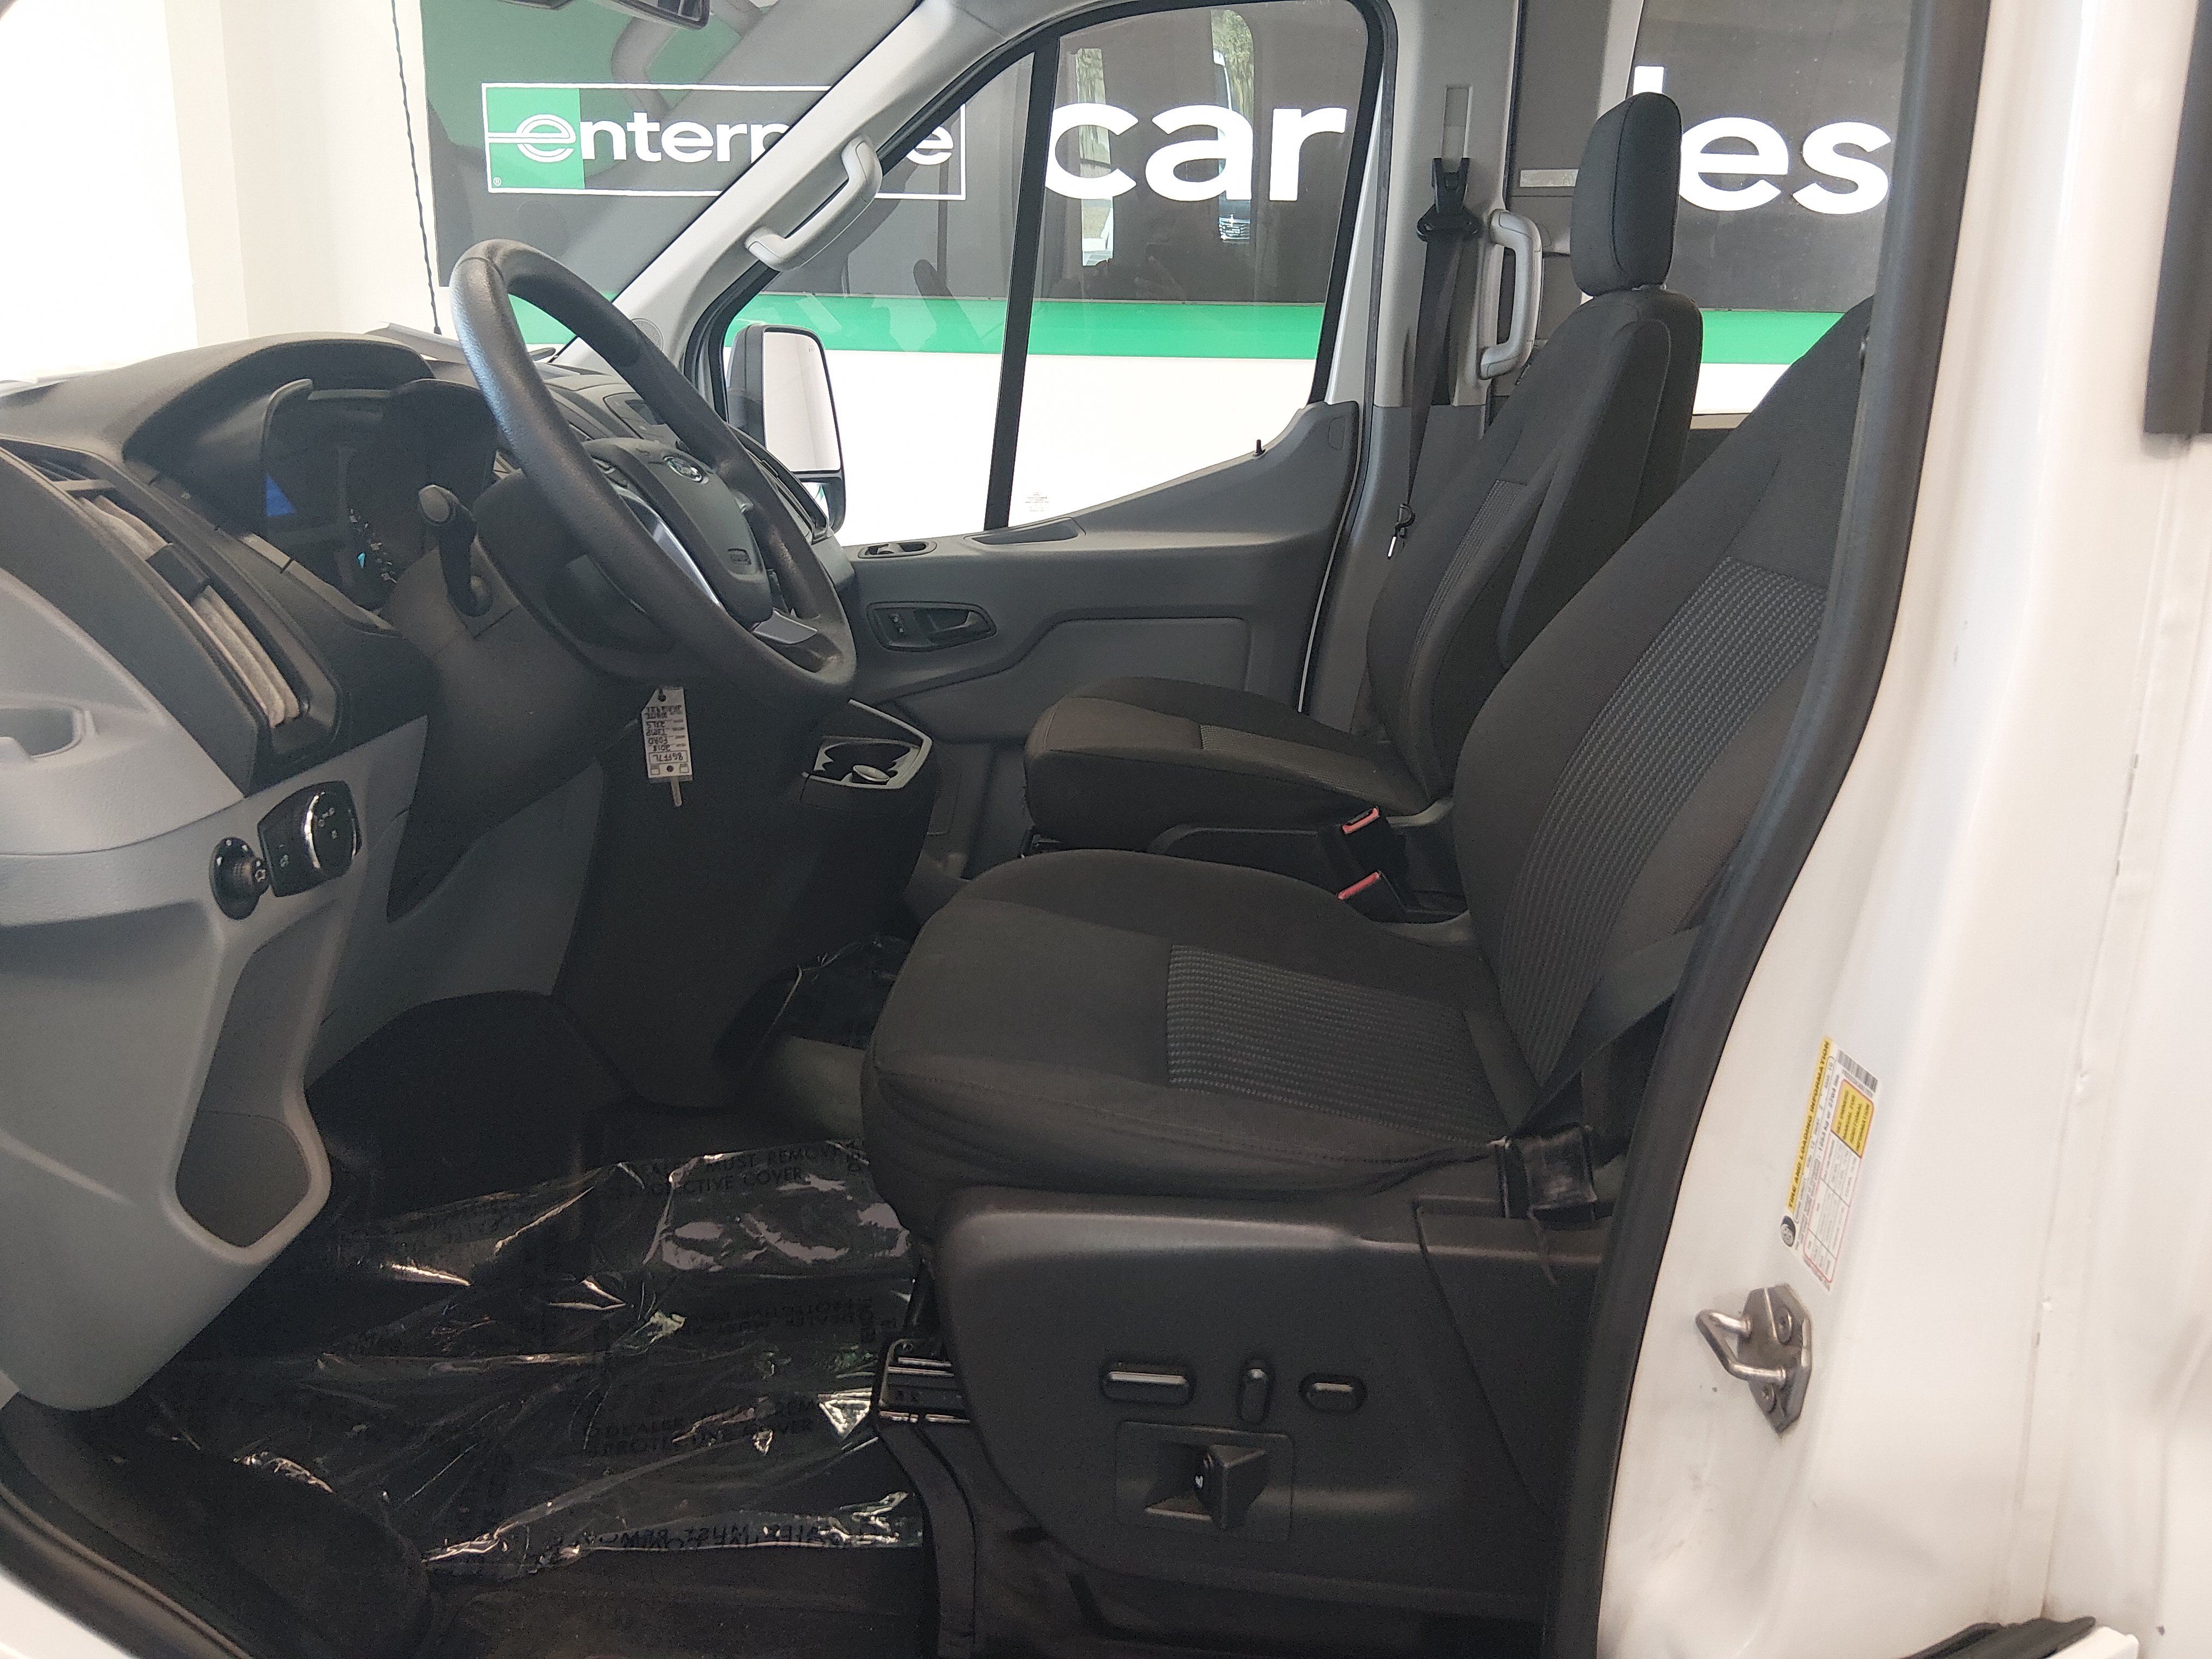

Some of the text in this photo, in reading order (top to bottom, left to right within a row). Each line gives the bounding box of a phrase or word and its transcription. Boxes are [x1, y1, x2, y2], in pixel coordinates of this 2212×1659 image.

[1045, 102, 1348, 202] car
[1799, 1114, 1812, 1161] LOADING
[1810, 1040, 1829, 1114] INFORMATION
